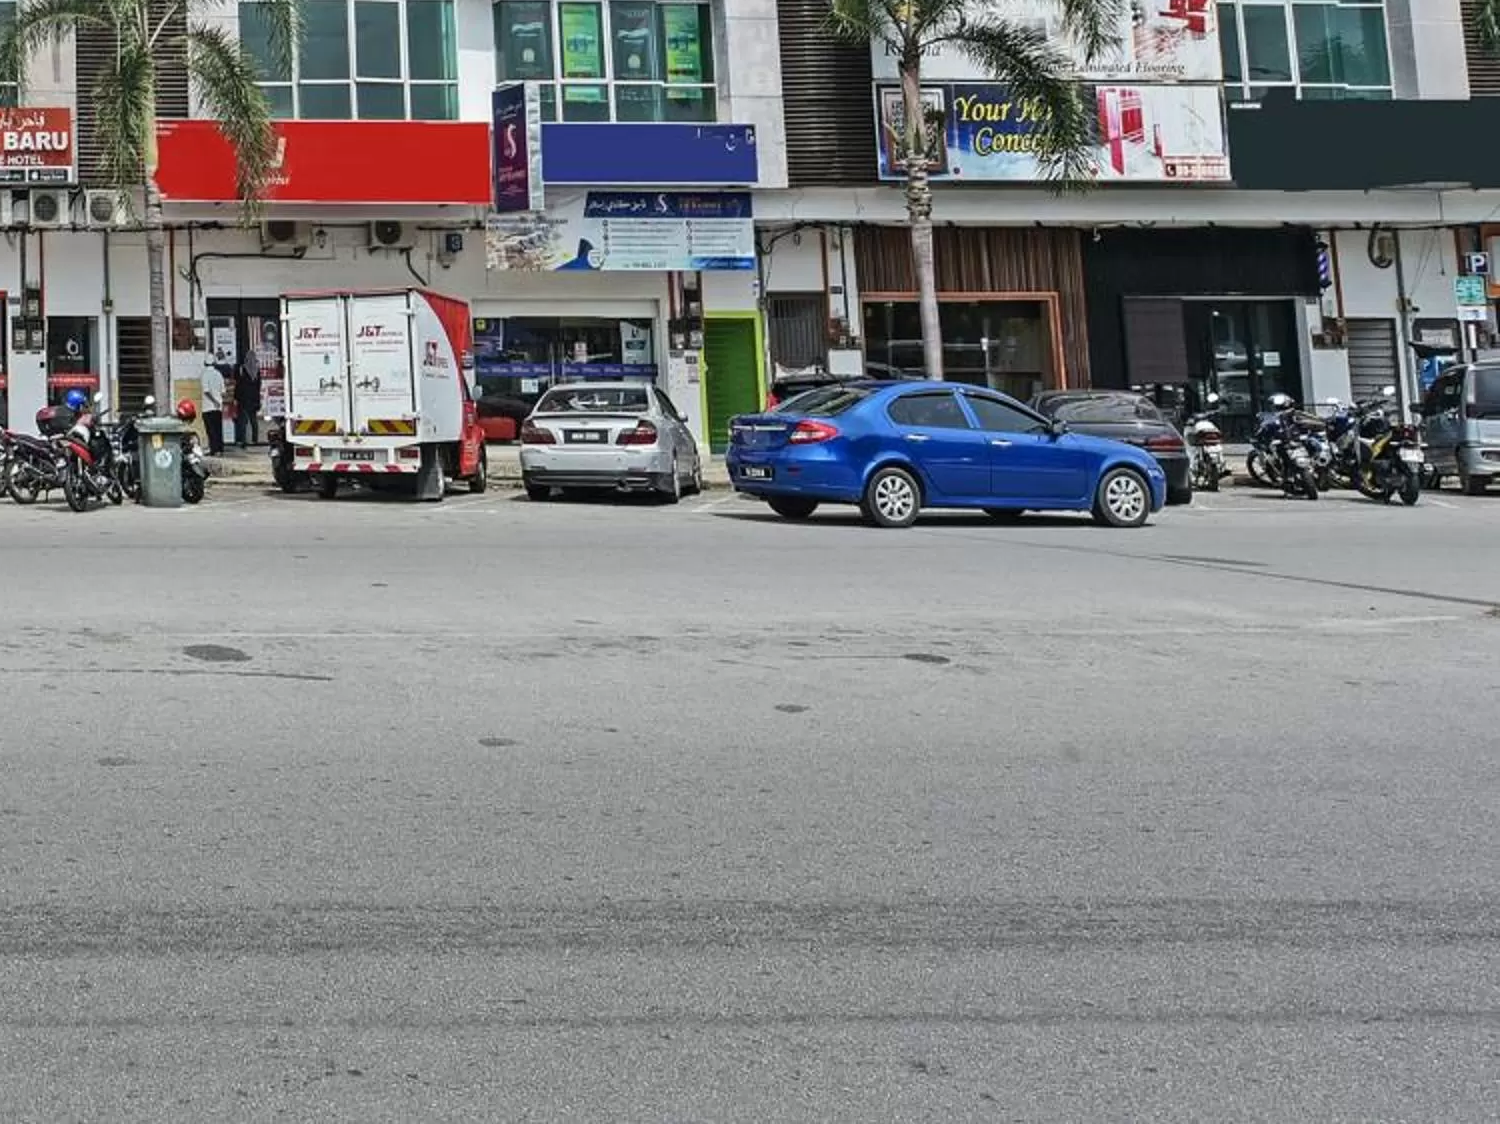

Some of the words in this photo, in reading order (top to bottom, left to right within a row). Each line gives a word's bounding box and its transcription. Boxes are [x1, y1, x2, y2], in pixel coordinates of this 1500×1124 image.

[954, 94, 1012, 122] Your
[3, 131, 69, 151] BARU
[7, 155, 44, 165] HOTEL
[1471, 255, 1485, 272] P
[295, 327, 322, 339] J&T
[356, 325, 386, 337] J&T
